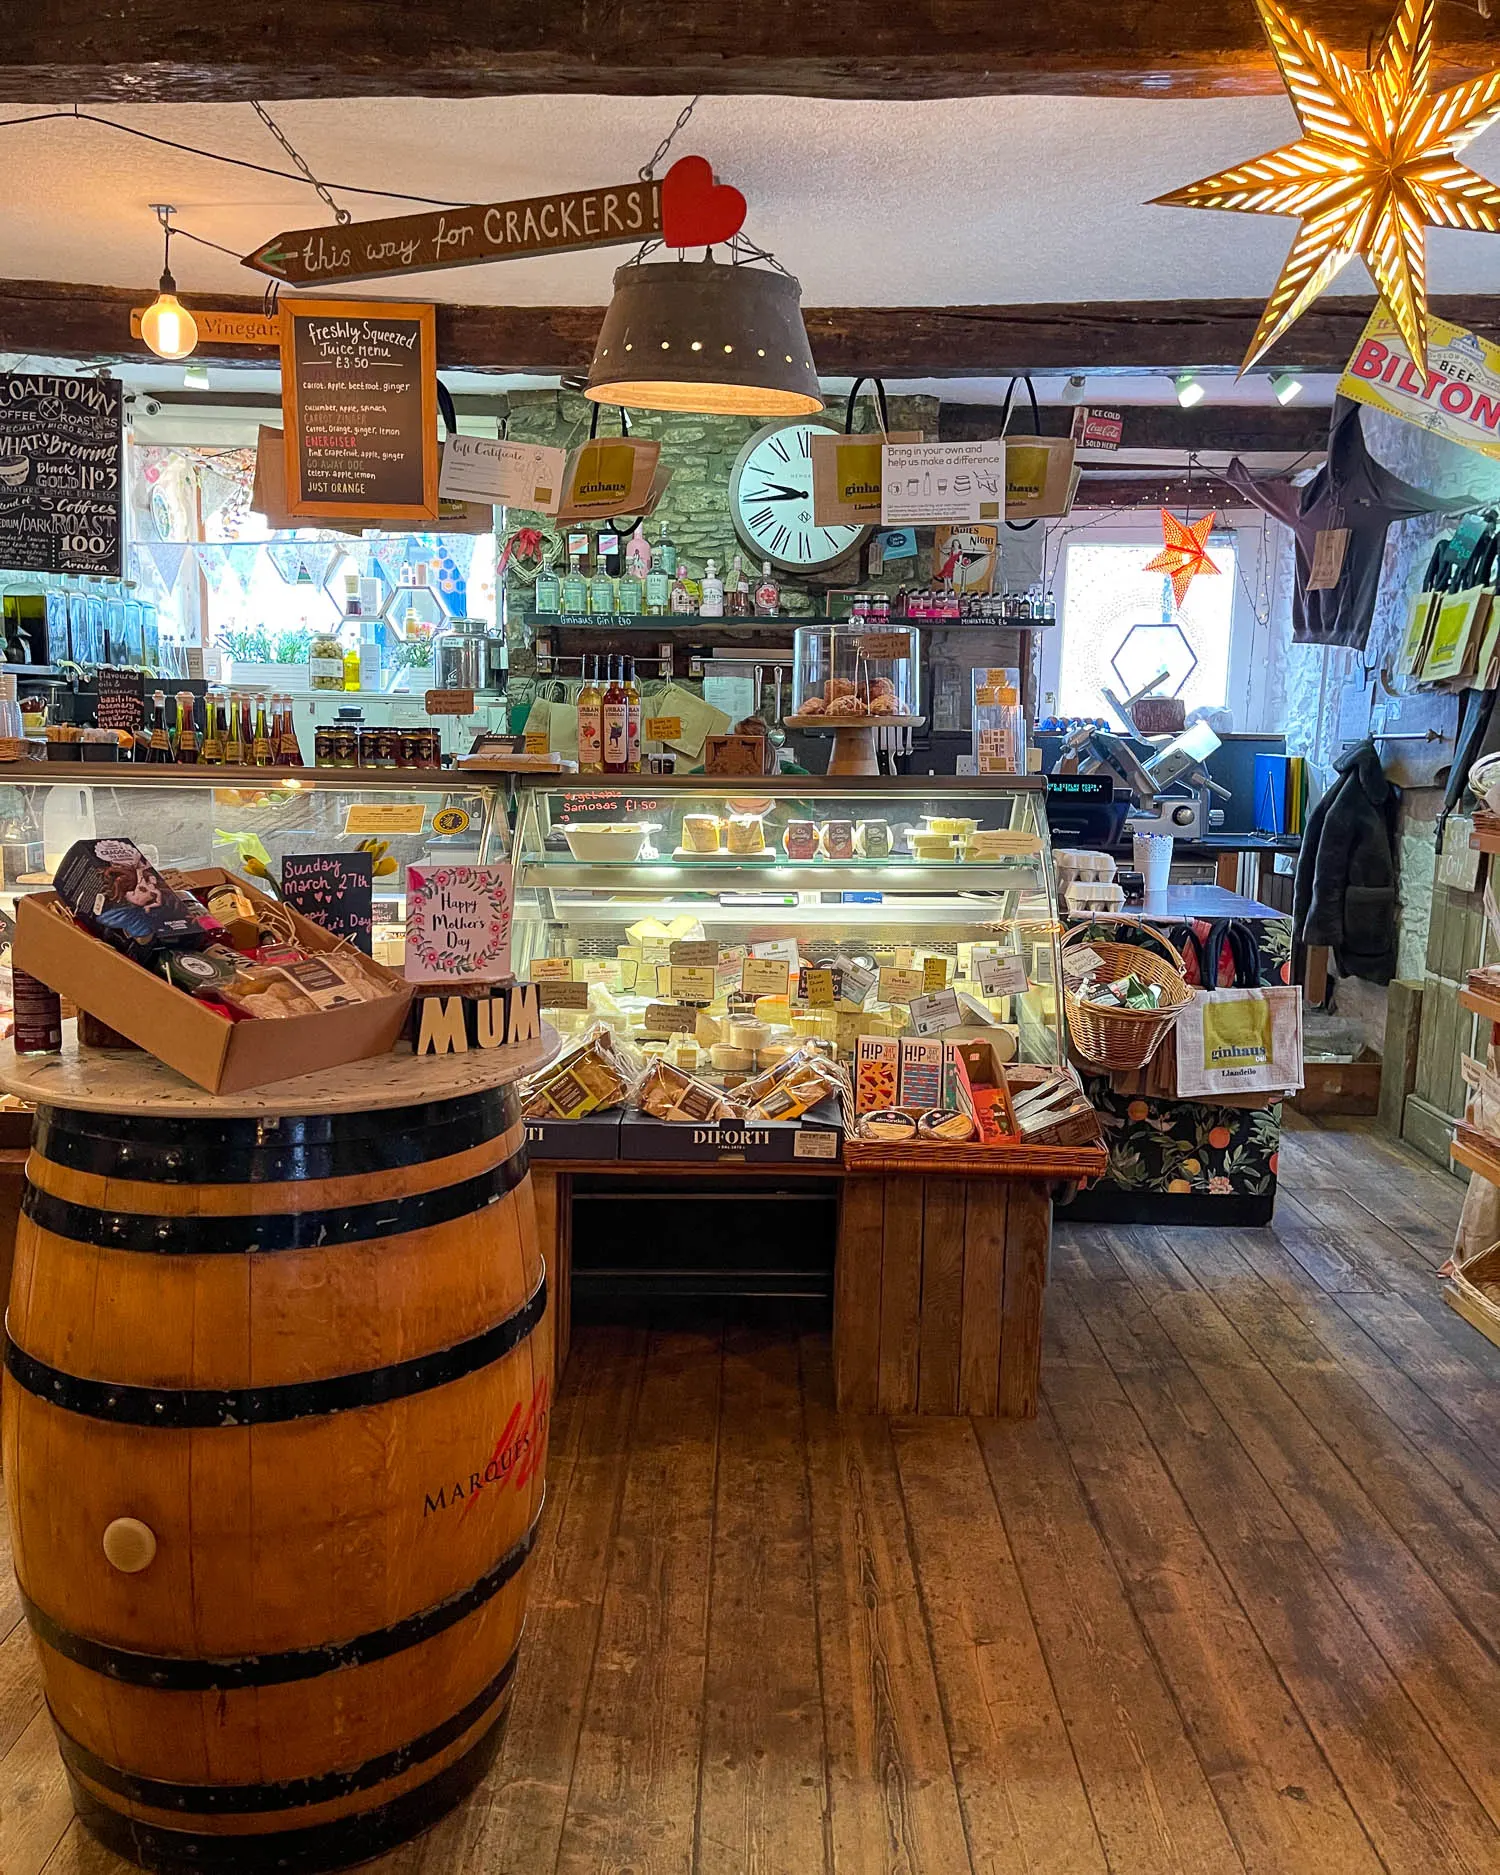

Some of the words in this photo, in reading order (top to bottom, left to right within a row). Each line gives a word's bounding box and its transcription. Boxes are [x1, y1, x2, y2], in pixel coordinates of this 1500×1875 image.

[303, 237, 351, 272] this
[367, 238, 421, 265] way
[432, 217, 474, 260] for
[484, 186, 659, 245] CRACKERS!
[205, 317, 280, 340] Vinegar
[363, 321, 417, 350] Squeezed
[319, 341, 354, 357] Juice
[1440, 360, 1476, 382] BEEF
[383, 382, 411, 393] ginger
[60, 413, 118, 428] ROASTRS
[1091, 409, 1104, 417] ICE
[1104, 410, 1121, 420] COLD
[304, 435, 357, 448] ENERGISER
[1085, 439, 1101, 448] SOLD
[1101, 441, 1118, 450] HERE
[47, 435, 118, 465] Brewing
[887, 447, 912, 458] Bring
[913, 447, 922, 455] in
[923, 448, 943, 458] your
[965, 444, 983, 454] and
[37, 462, 76, 475] Black
[887, 458, 907, 468] help
[908, 458, 919, 466] us
[920, 457, 944, 466] make
[953, 455, 1000, 465] difference
[36, 475, 79, 489] GOLD
[307, 482, 328, 492] JUST
[331, 482, 366, 494] ORANGE
[579, 481, 625, 494] ginhaus
[51, 514, 117, 537] ROAST
[60, 535, 116, 554] 100%
[970, 535, 994, 546] NIGHT
[563, 801, 618, 812] Samosas
[284, 858, 342, 878] Sunday
[338, 873, 370, 890] 27th
[440, 892, 478, 914] Happy
[350, 913, 372, 933] Day
[432, 913, 486, 932] Mother's
[446, 931, 471, 952] Day
[417, 984, 541, 1056] MUM
[1211, 1044, 1266, 1061] ginhaus
[693, 1130, 769, 1145] DIFORTI
